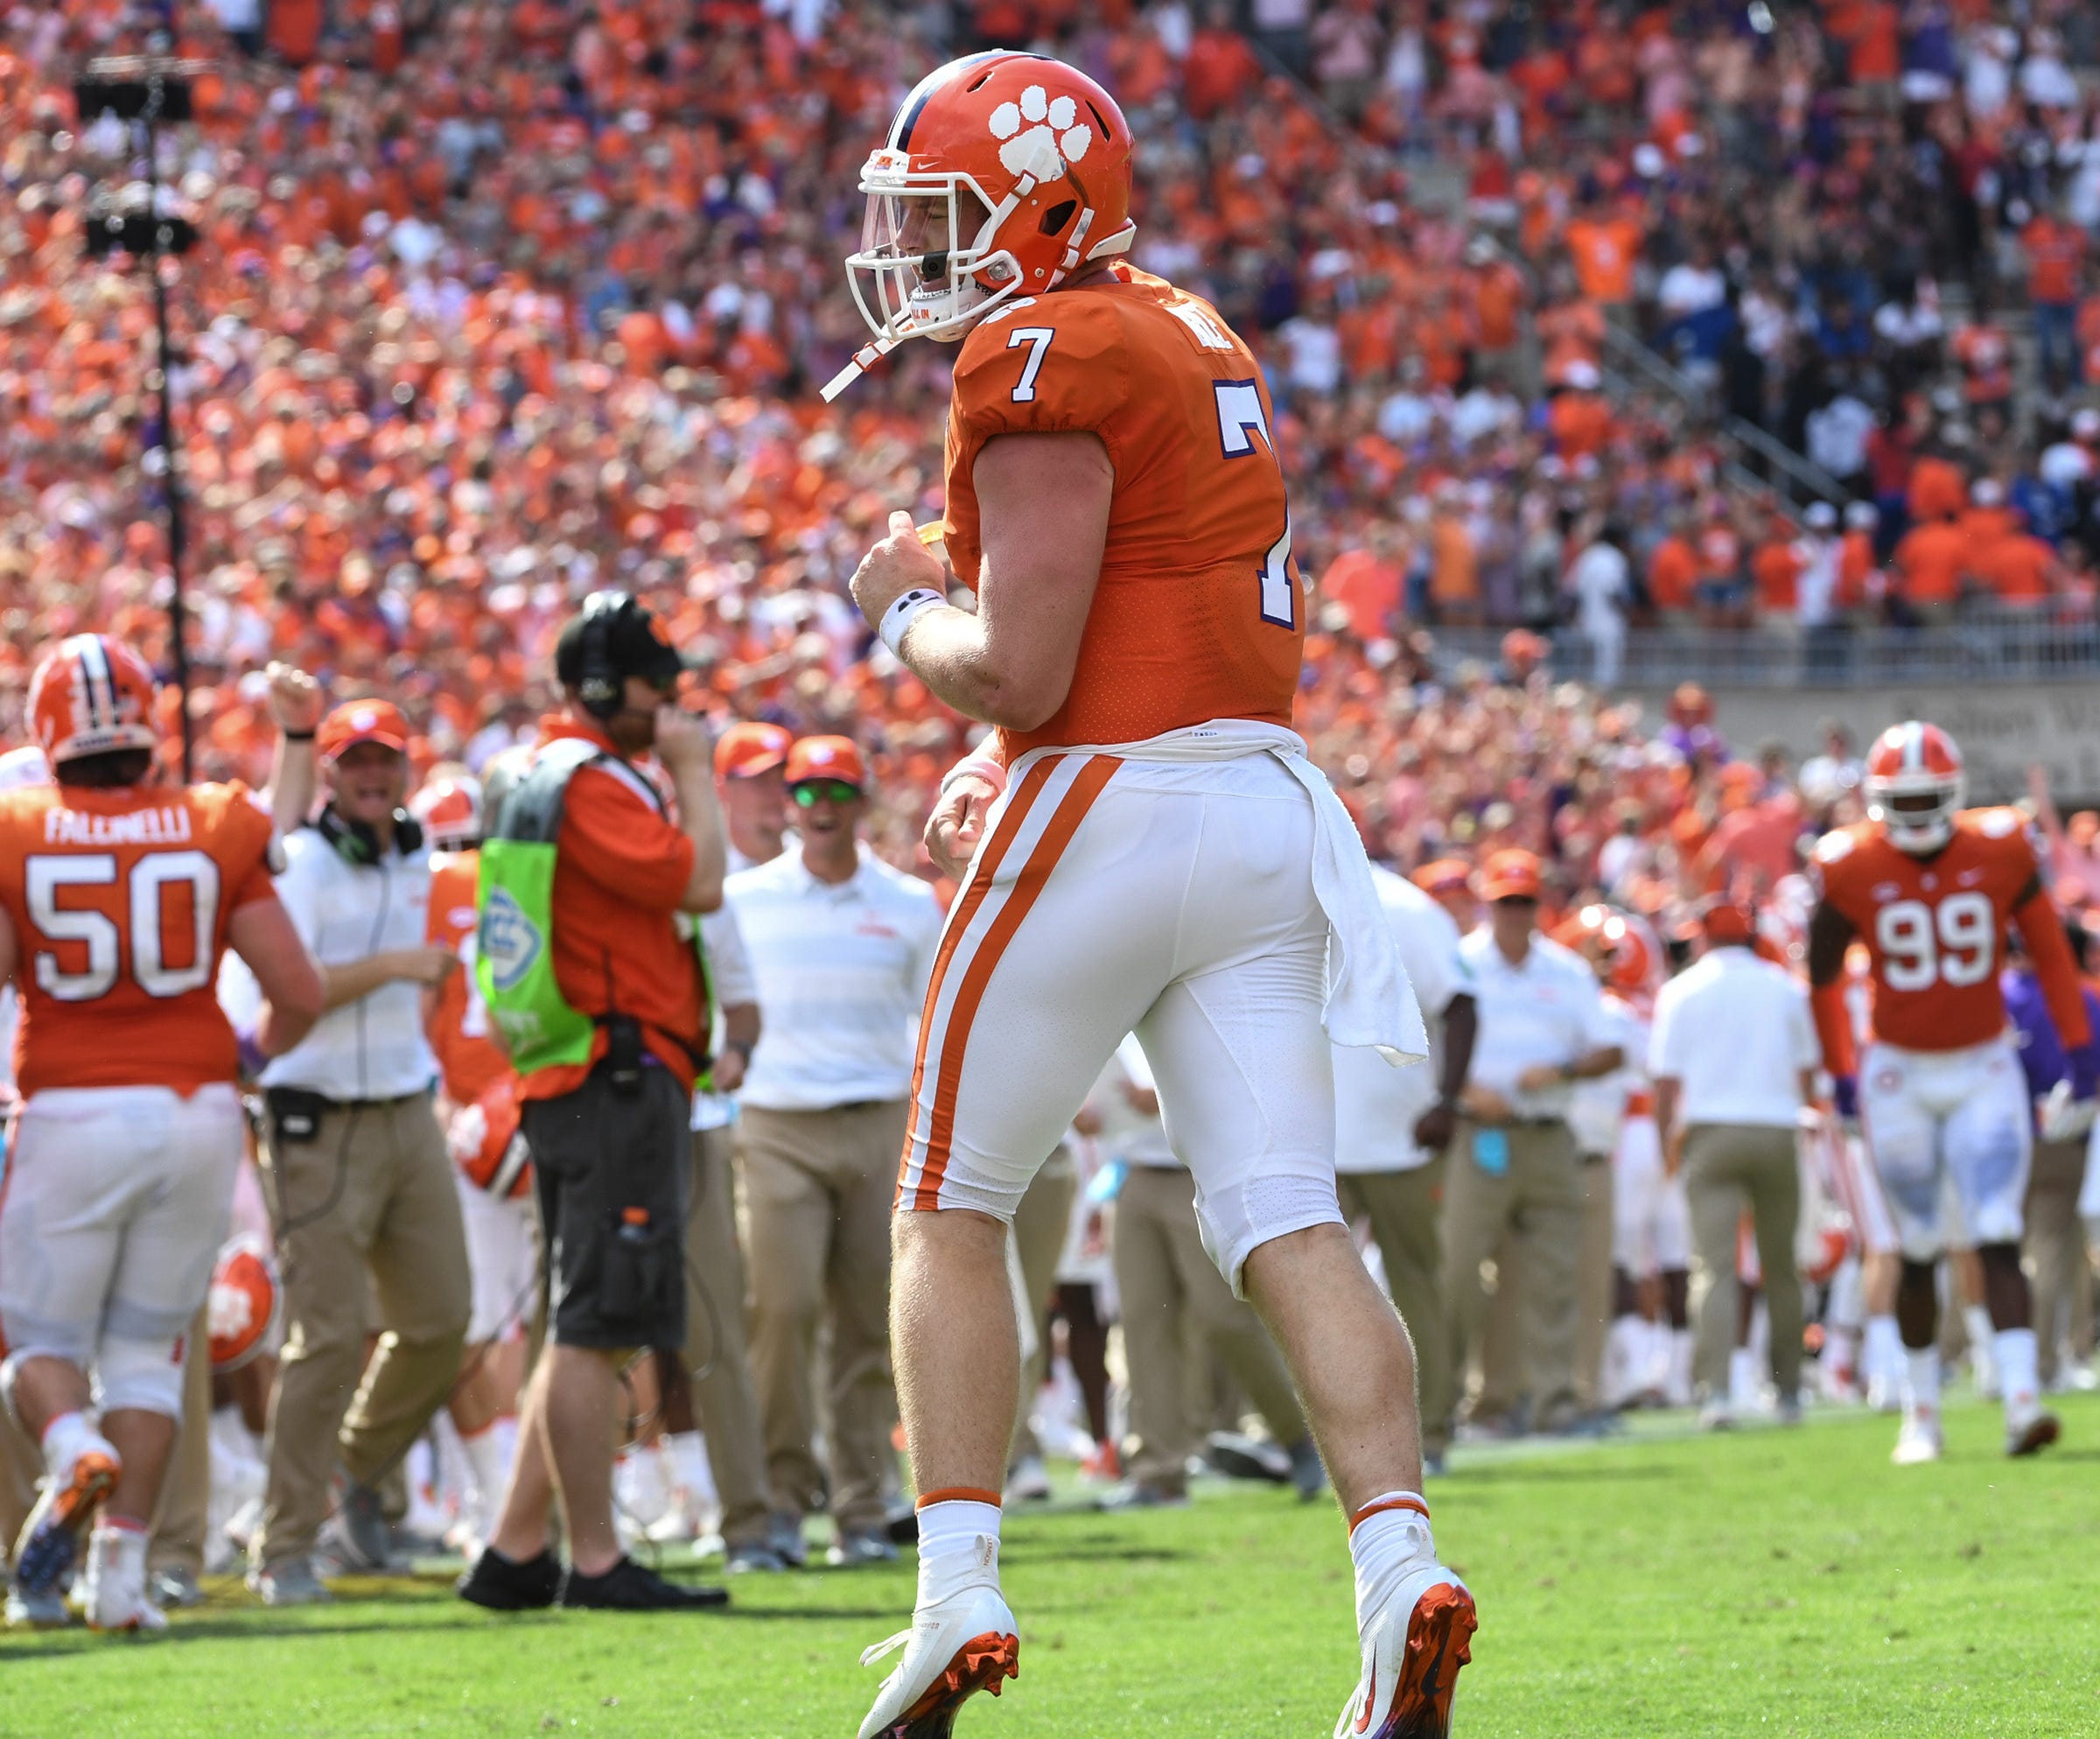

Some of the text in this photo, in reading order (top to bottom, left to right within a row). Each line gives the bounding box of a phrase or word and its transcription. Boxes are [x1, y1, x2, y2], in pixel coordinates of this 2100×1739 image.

[1006, 326, 1055, 403] 7
[25, 850, 220, 1000] 50
[1875, 890, 1996, 992] 99
